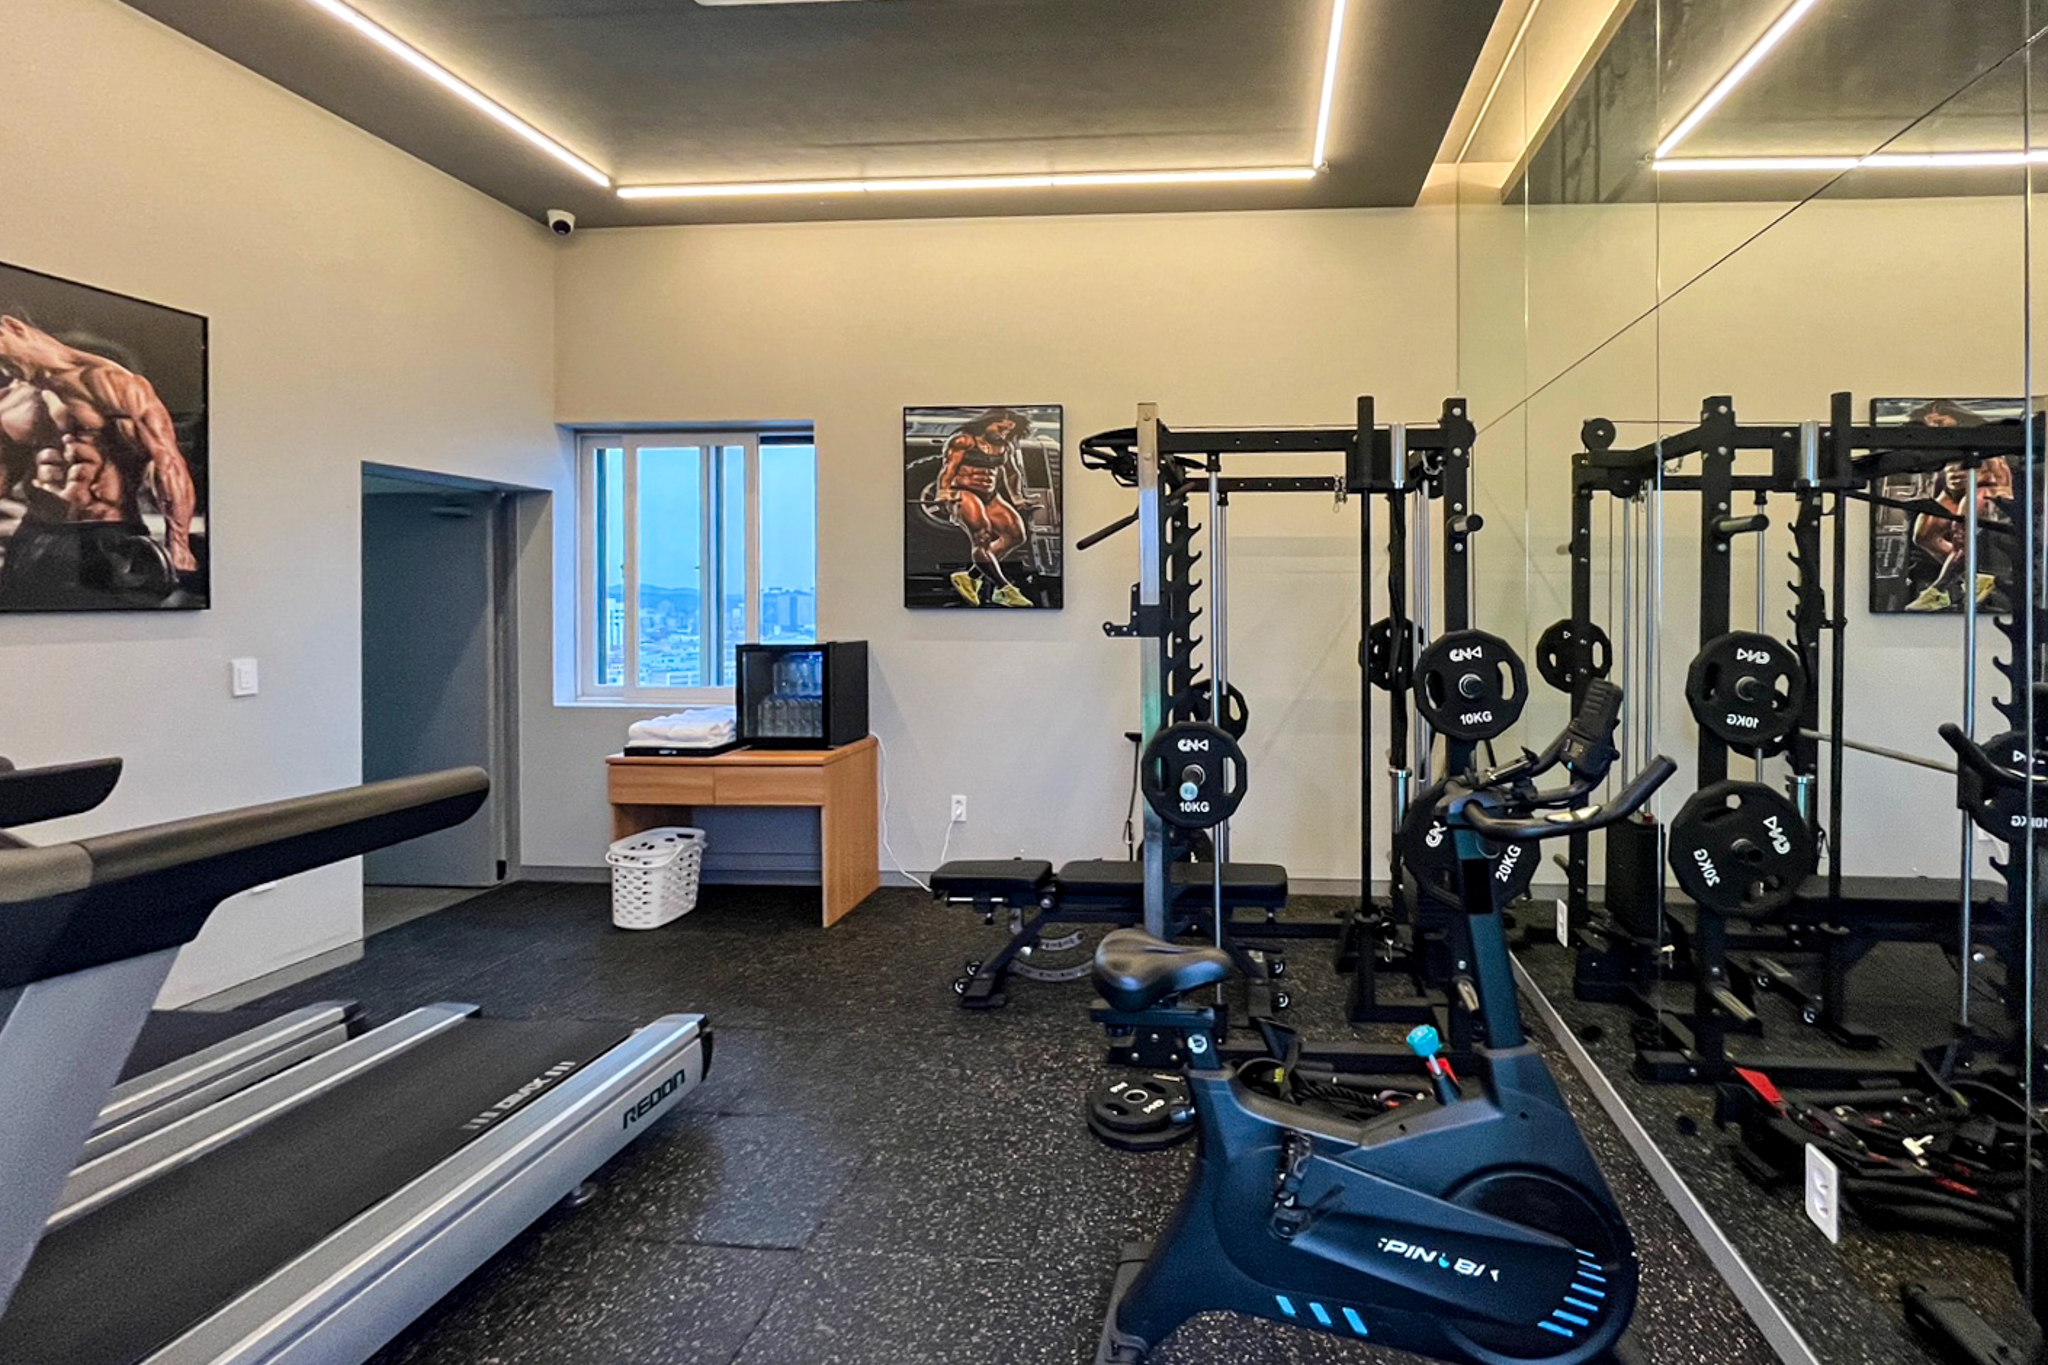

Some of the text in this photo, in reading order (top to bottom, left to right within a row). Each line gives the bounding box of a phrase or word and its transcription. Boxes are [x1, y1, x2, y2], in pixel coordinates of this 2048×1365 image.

[1460, 710, 1493, 725] 10KG
[1179, 801, 1210, 813] 10KG
[1494, 844, 1522, 883] 20KG
[622, 1068, 685, 1130] REDON
